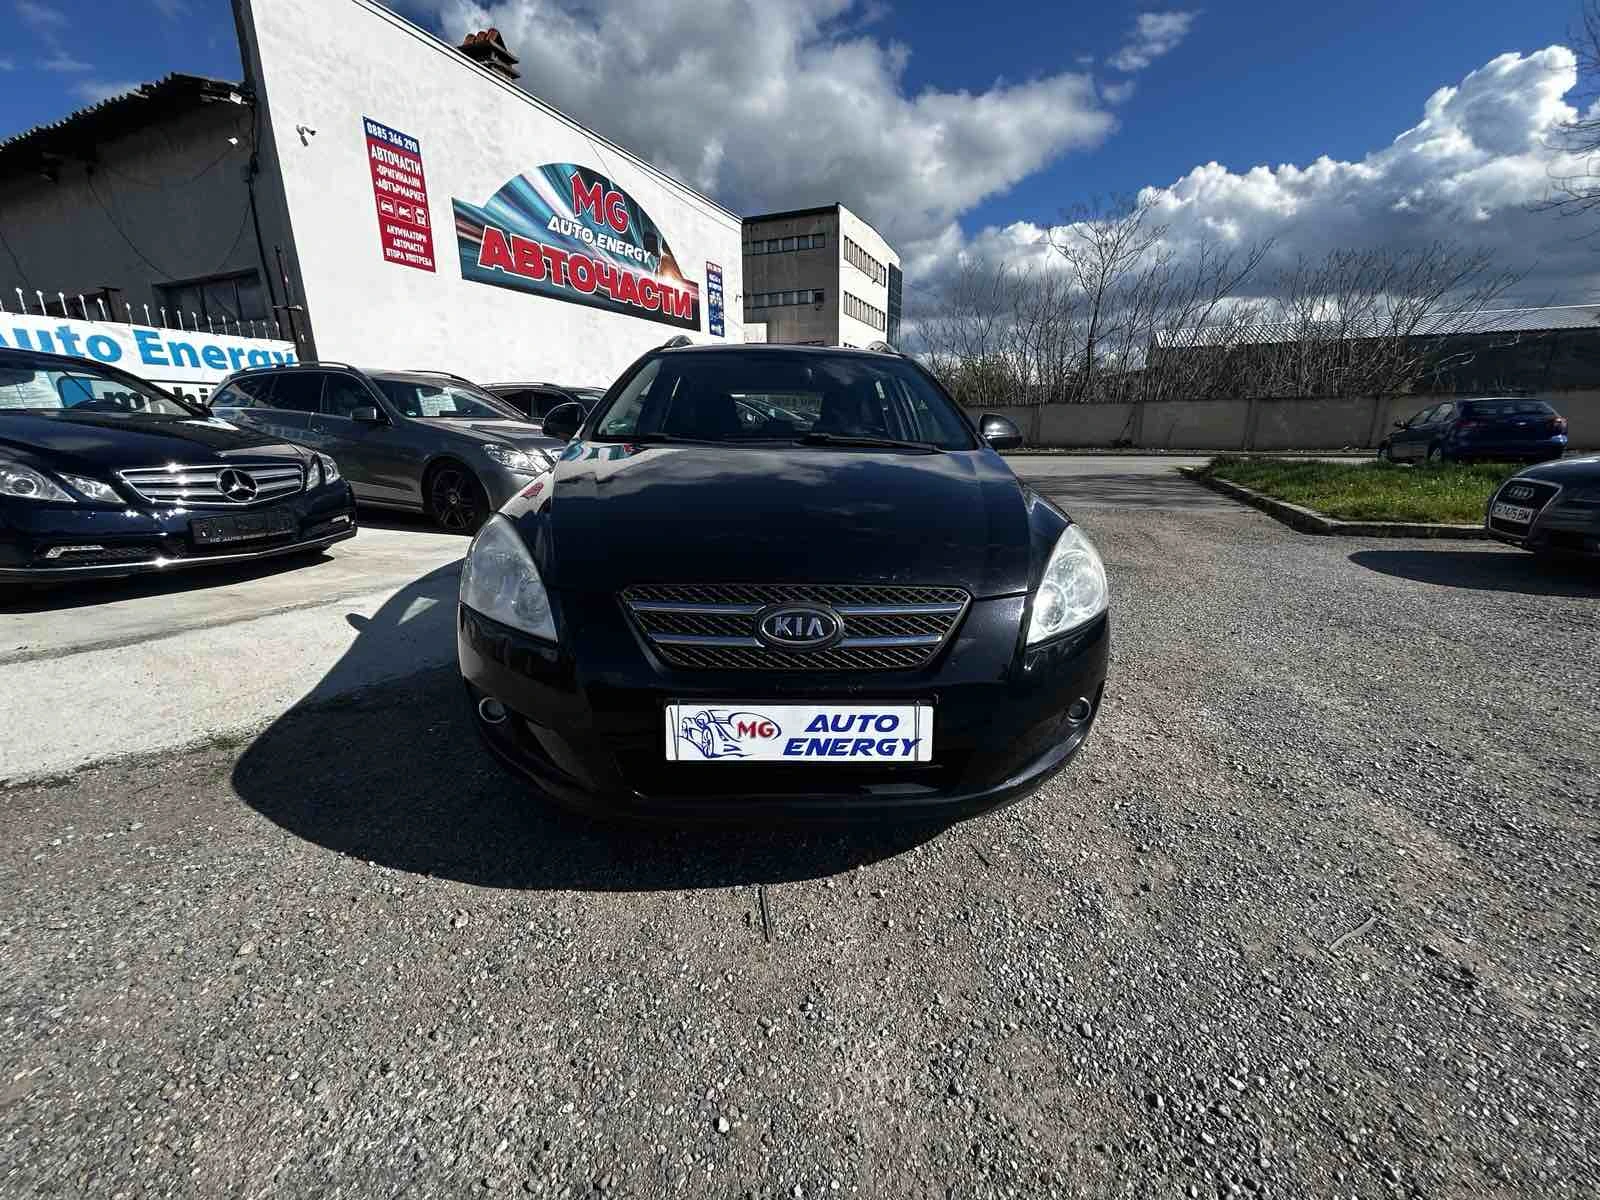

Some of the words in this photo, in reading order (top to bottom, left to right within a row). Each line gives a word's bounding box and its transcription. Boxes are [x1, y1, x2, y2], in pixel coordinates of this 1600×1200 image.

[371, 143, 421, 175] АВТОЧАСТИ
[570, 171, 629, 234] MG
[548, 215, 593, 244] AUTO
[595, 233, 652, 264] ENERGY
[478, 225, 693, 320] АВТОЧАСТИ
[774, 616, 824, 637] KIA
[736, 720, 775, 739] MG
[804, 714, 899, 733] AUTO
[782, 738, 922, 757] ENERGY
